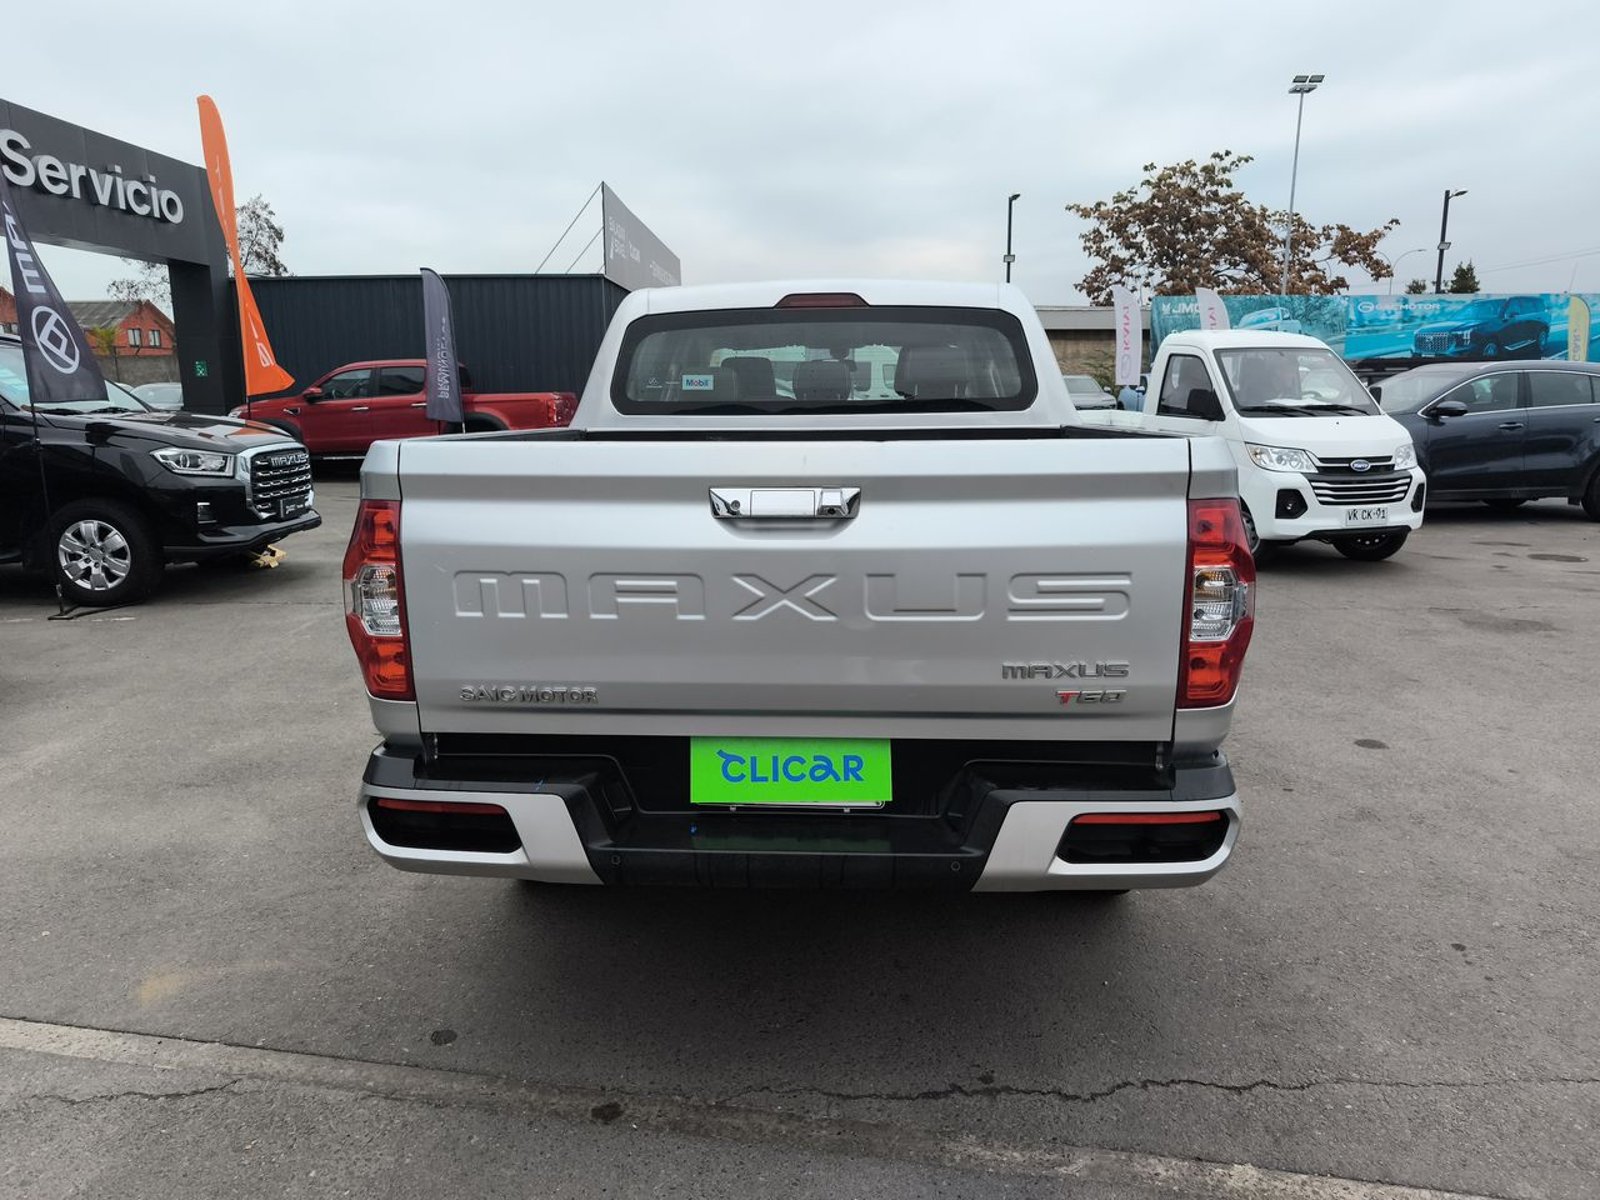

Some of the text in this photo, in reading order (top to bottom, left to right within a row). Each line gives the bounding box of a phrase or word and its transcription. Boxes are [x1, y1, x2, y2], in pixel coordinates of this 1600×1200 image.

[0, 128, 185, 225] Servicio
[685, 379, 710, 387] Mobil
[270, 453, 309, 467] MAXUS
[453, 570, 1133, 621] MAXUS
[1001, 660, 1130, 679] MAXUS
[459, 685, 598, 703] SAIC MOTOR
[1054, 688, 1128, 704] T60
